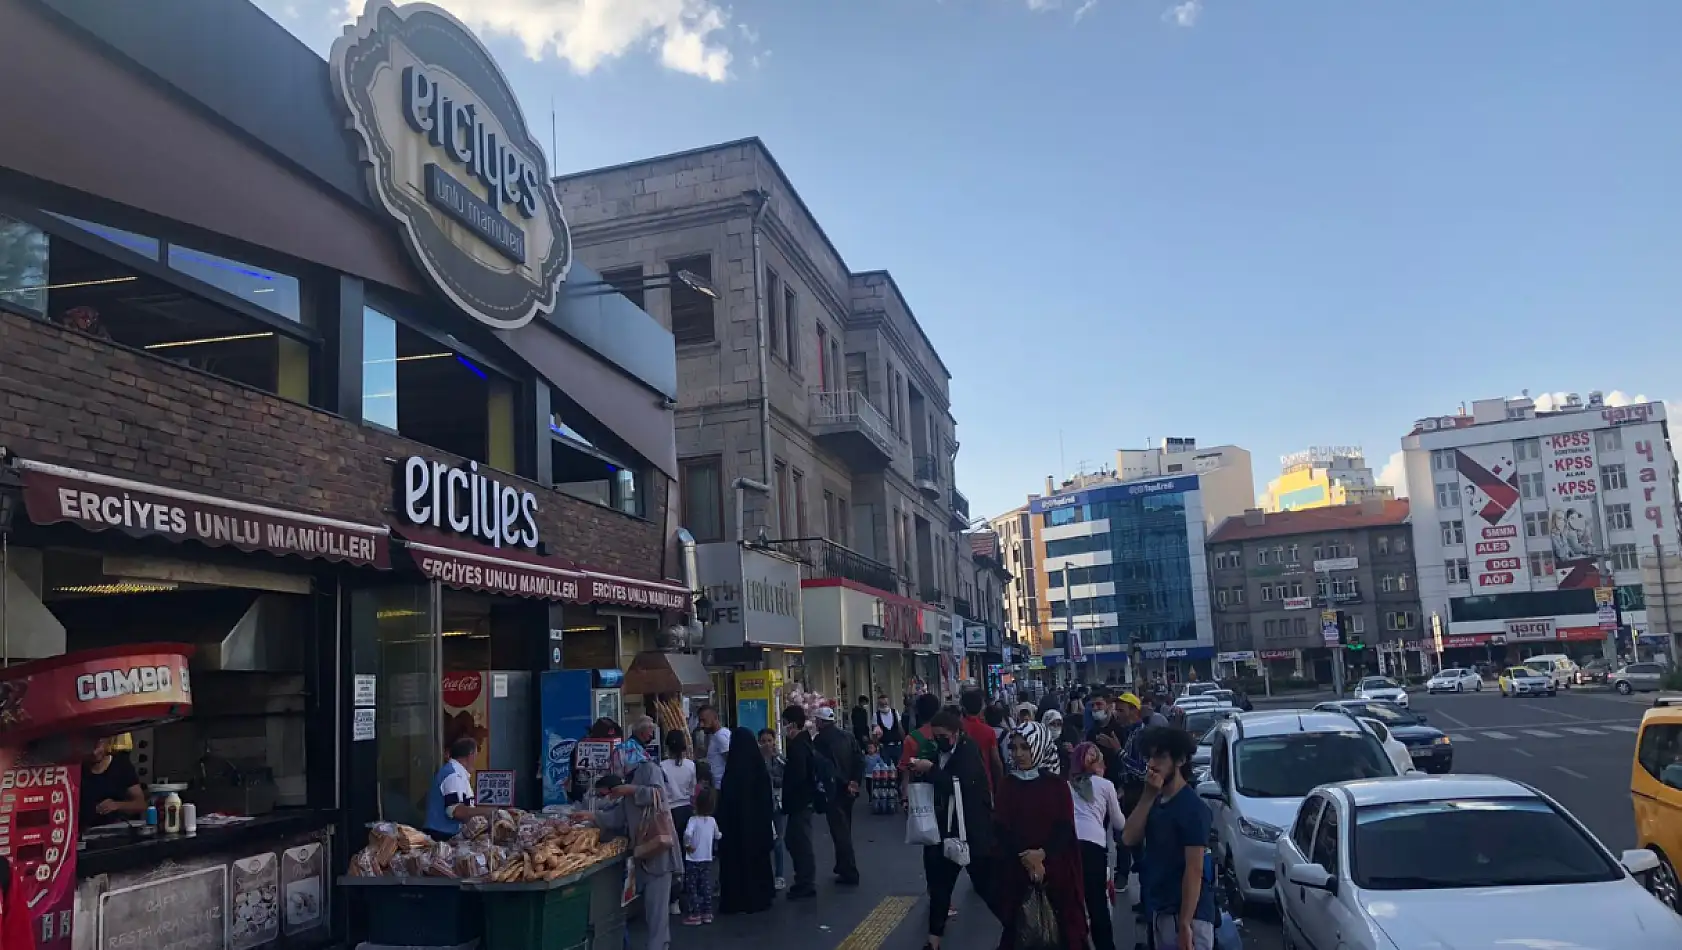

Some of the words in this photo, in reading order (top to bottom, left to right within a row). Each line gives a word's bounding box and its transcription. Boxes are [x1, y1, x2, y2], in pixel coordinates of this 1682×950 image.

[404, 66, 539, 217] erciyes
[436, 178, 464, 213] unlu
[1551, 431, 1590, 449] KPSS
[1555, 455, 1593, 472] KPSS
[1558, 479, 1597, 495] KPSS
[405, 456, 539, 548] erciyes
[58, 487, 187, 534] ERCİYES
[195, 510, 261, 546] UNLU
[267, 524, 376, 561] MAMÜLLERİ
[1486, 527, 1516, 537] SMMM
[1479, 542, 1507, 552] ALES
[1493, 559, 1517, 569] DGS
[422, 558, 482, 586] ERCİYES
[486, 568, 517, 591] UNLU
[520, 576, 579, 599] MAMÜLLERİ
[592, 582, 626, 601] ERCİYES
[627, 587, 648, 604] UNLU
[648, 590, 685, 609] MAMÜLLERİ
[77, 665, 173, 702] COMBO
[2, 766, 68, 789] BOXER
